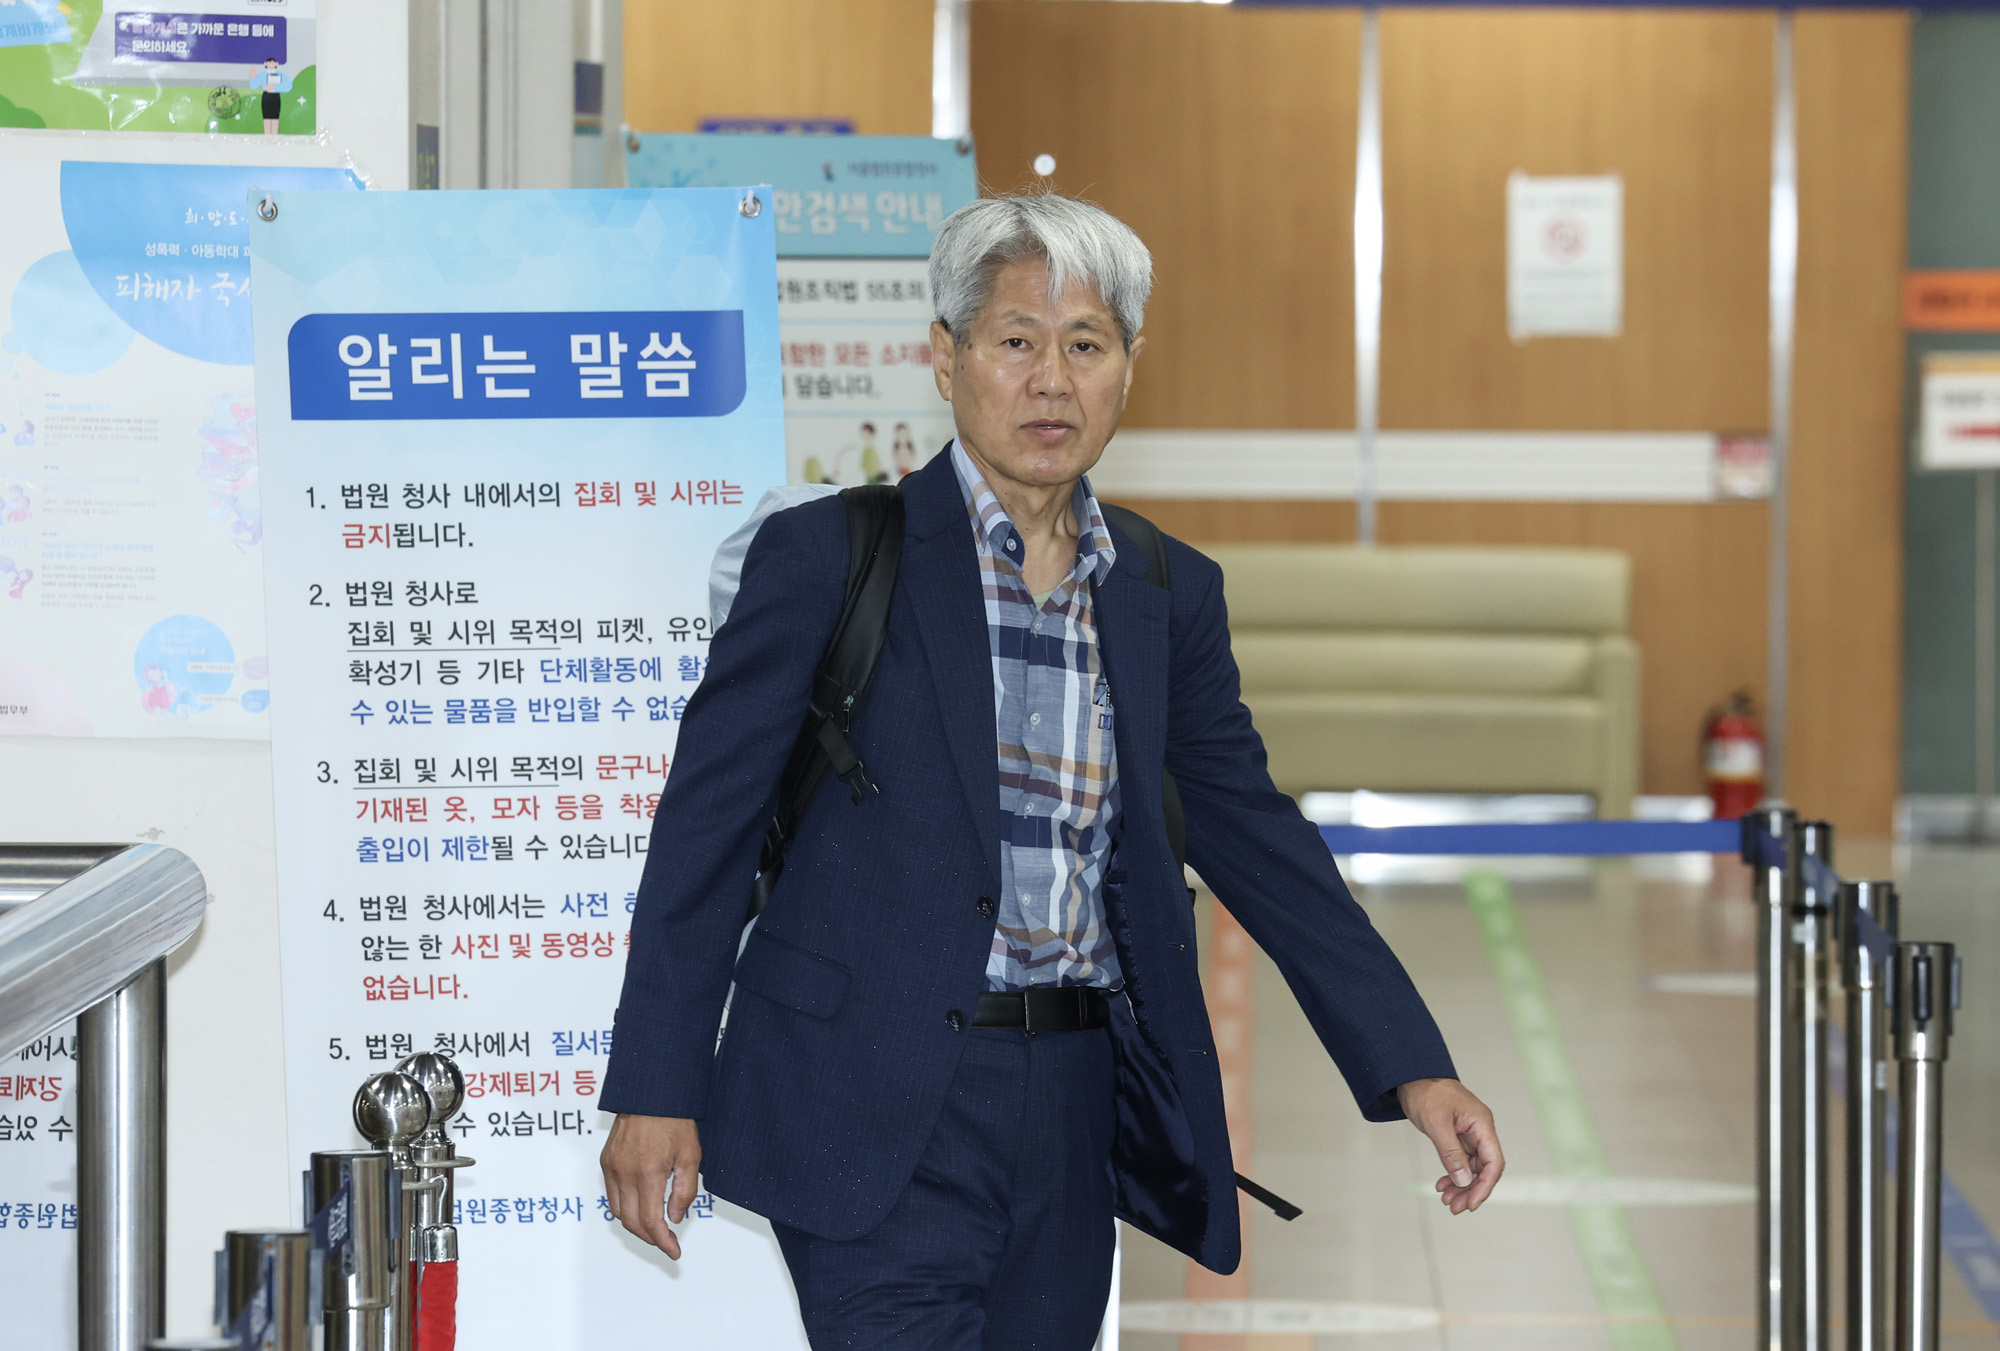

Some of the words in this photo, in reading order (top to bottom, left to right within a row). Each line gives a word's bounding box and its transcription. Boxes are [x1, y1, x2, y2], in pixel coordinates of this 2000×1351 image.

[191, 23, 224, 36] 가까운
[227, 24, 249, 37] 은행
[252, 24, 274, 38] 등에
[185, 207, 249, 227] 희·망·도·
[876, 190, 943, 234] 안내
[145, 243, 180, 257] 성폭력
[192, 244, 239, 258] 아동학대
[116, 272, 202, 301] 피해자
[339, 334, 535, 400] 알리는
[571, 332, 696, 398] 말씀
[834, 341, 870, 367] 모든
[306, 487, 325, 509] 1.
[341, 484, 388, 509] 법원
[403, 483, 450, 509] 청사
[464, 482, 560, 508] 내에서의
[575, 482, 620, 506] 집회
[635, 481, 656, 506] 및
[671, 480, 743, 505] 시위는
[342, 523, 473, 548] 금지됩니다.
[310, 584, 330, 607] 2.
[346, 581, 393, 606] 법원
[406, 581, 478, 606] 청사로
[348, 621, 394, 646] 집회
[410, 620, 432, 645] 및
[448, 620, 494, 645] 시위
[510, 619, 581, 644] 목적의
[597, 618, 652, 644] 피켓,
[349, 660, 421, 686] 확성기
[437, 660, 461, 685] 등
[478, 659, 524, 684] 기타
[541, 657, 661, 683] 단체활동에
[677, 655, 708, 681] 활
[351, 700, 374, 725] 수
[386, 700, 433, 724] 있는
[444, 698, 517, 724] 물품을
[529, 697, 601, 722] 반입할
[612, 697, 635, 721] 수
[318, 761, 338, 784] 3.
[354, 758, 400, 783] 집회
[415, 758, 436, 783] 및
[451, 757, 497, 782] 시위
[511, 756, 582, 781] 목적의
[596, 754, 670, 780] 문구나
[357, 797, 427, 823] 기재된
[444, 796, 474, 823] 옷,
[492, 796, 540, 820] 모자
[555, 795, 603, 820] 등을
[357, 837, 428, 862] 출입이
[442, 836, 513, 861] 제한될
[525, 835, 548, 860] 수
[323, 899, 344, 922] 4.
[360, 895, 407, 921] 법원
[424, 894, 545, 921] 청사에서는
[561, 892, 608, 918] 사전
[361, 936, 409, 962] 않는
[419, 935, 442, 960] 한
[451, 934, 499, 959] 사진
[510, 933, 531, 958] 및
[541, 932, 614, 958] 동영상
[363, 974, 468, 1001] 없습니다.
[330, 1038, 350, 1060] 5.
[366, 1034, 412, 1059] 법원
[434, 1032, 530, 1058] 청사에서
[465, 1071, 560, 1098] 강제퇴거
[573, 1071, 597, 1095] 등
[452, 1112, 476, 1136] 수
[488, 1110, 592, 1136] 있습니다.
